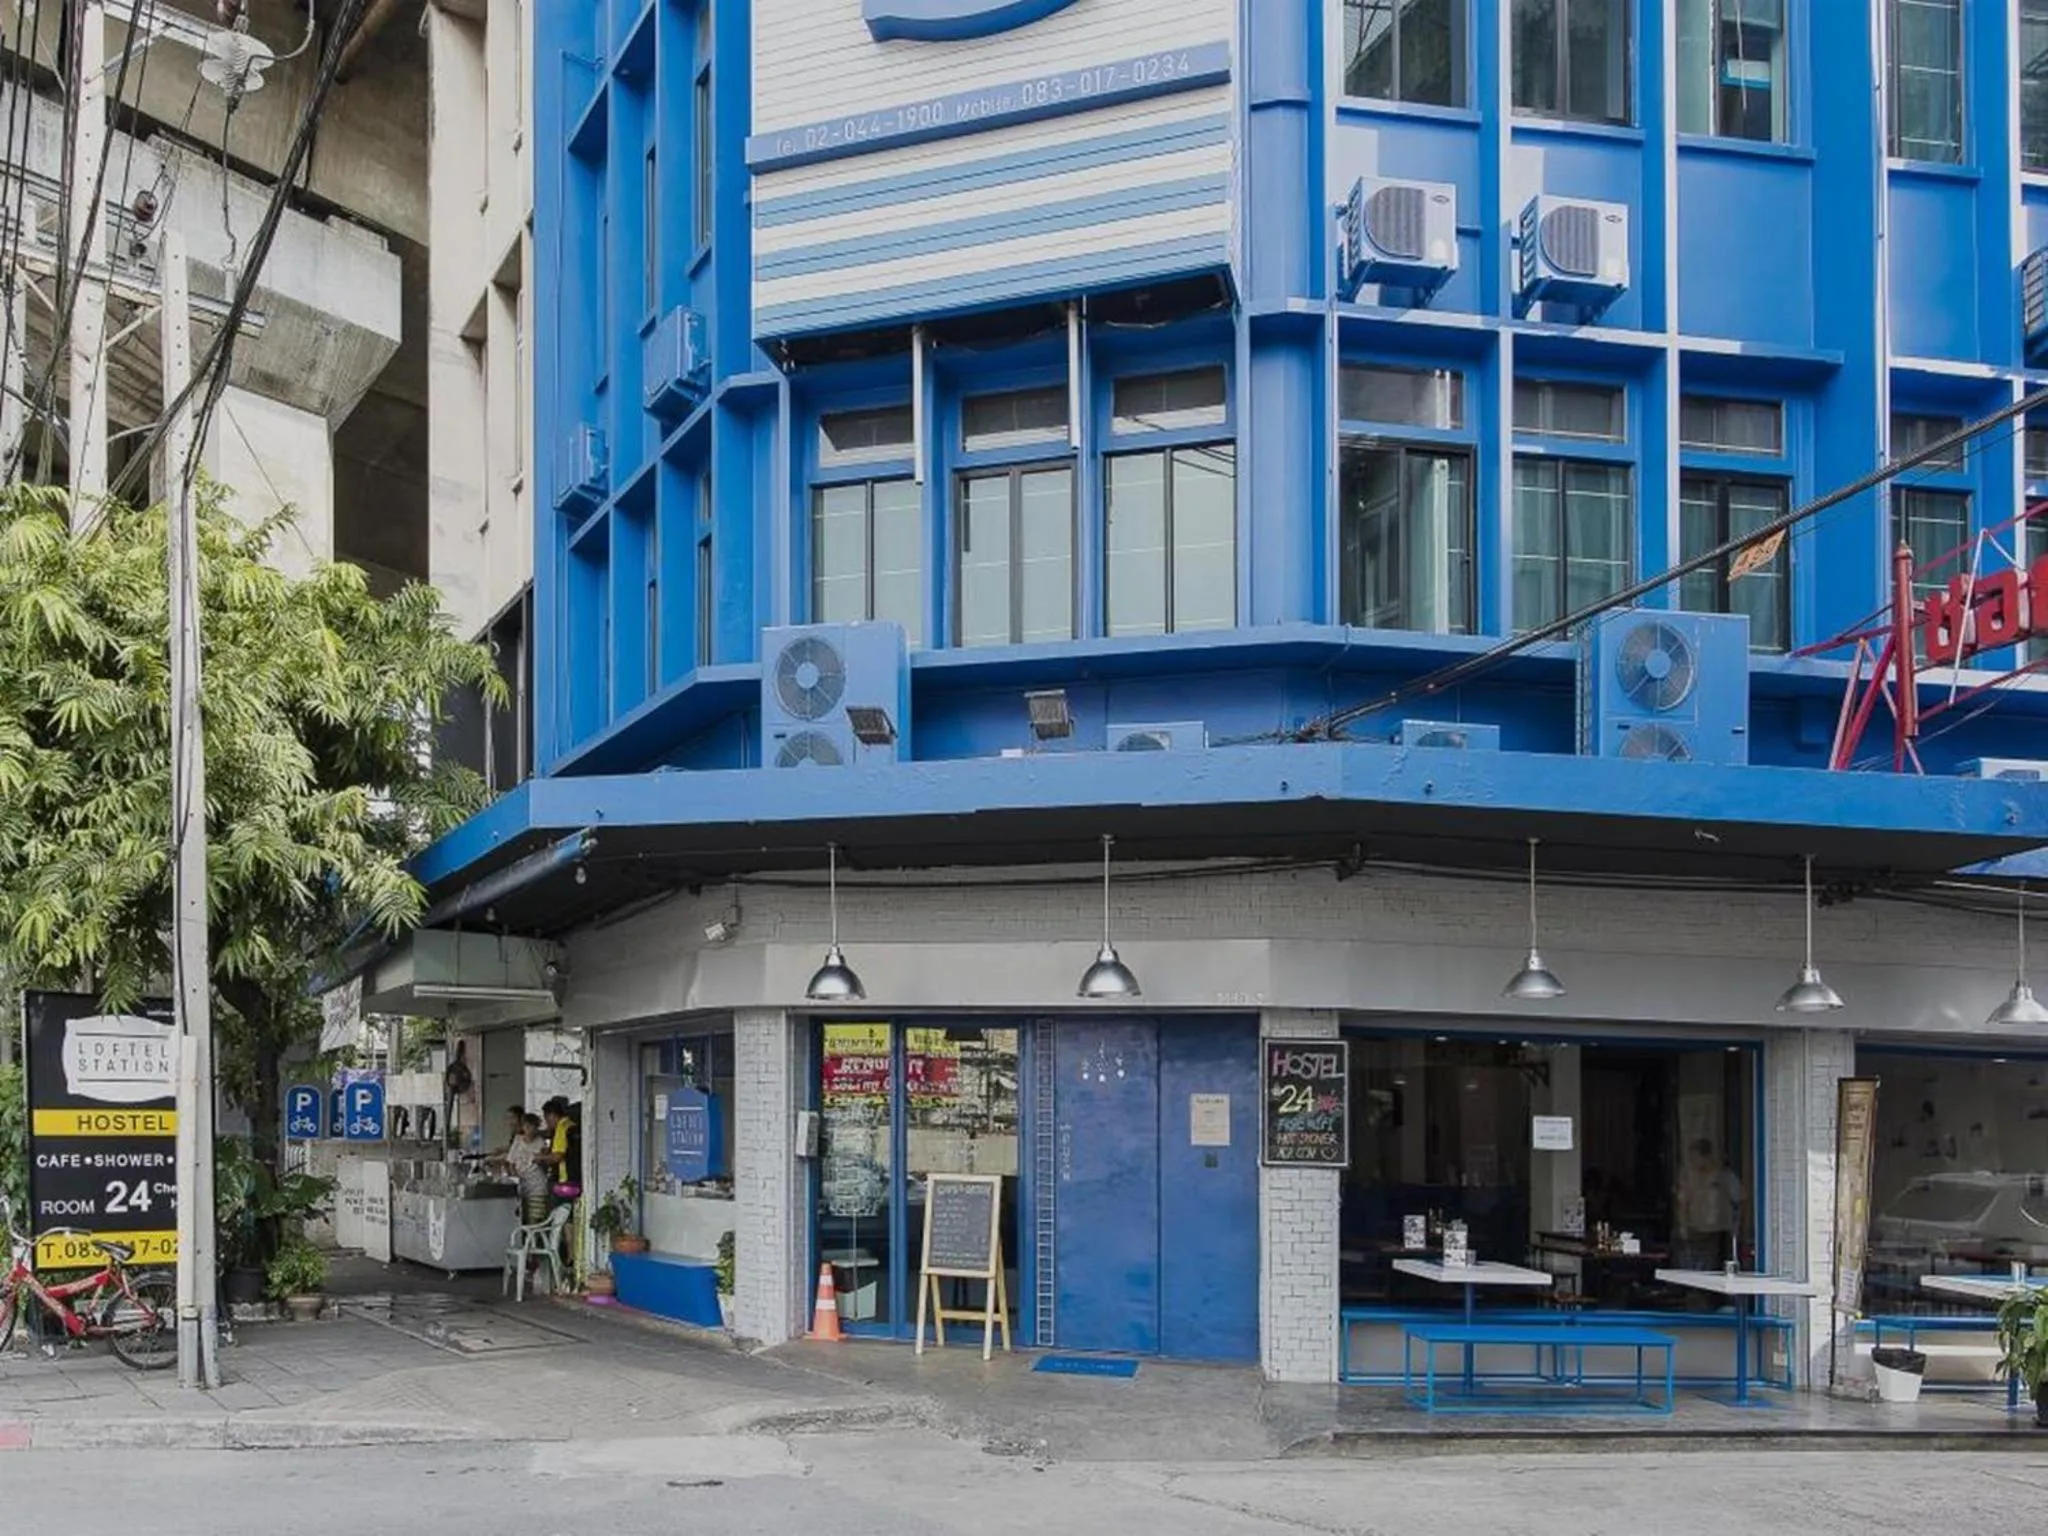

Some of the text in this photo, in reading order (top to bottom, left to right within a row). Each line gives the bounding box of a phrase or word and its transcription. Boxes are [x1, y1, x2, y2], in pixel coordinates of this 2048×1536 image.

[805, 101, 943, 150] 02-044-1900
[1021, 53, 1190, 104] 083-017-0234
[78, 1042, 168, 1057] LOFTEL
[78, 1058, 168, 1073] STATION
[296, 1093, 312, 1112] P
[355, 1089, 372, 1112] P
[1279, 1084, 1316, 1114] 24
[77, 1114, 170, 1131] HOSTEL
[36, 1154, 82, 1168] CAFE
[40, 1179, 152, 1215] ROOM 24
